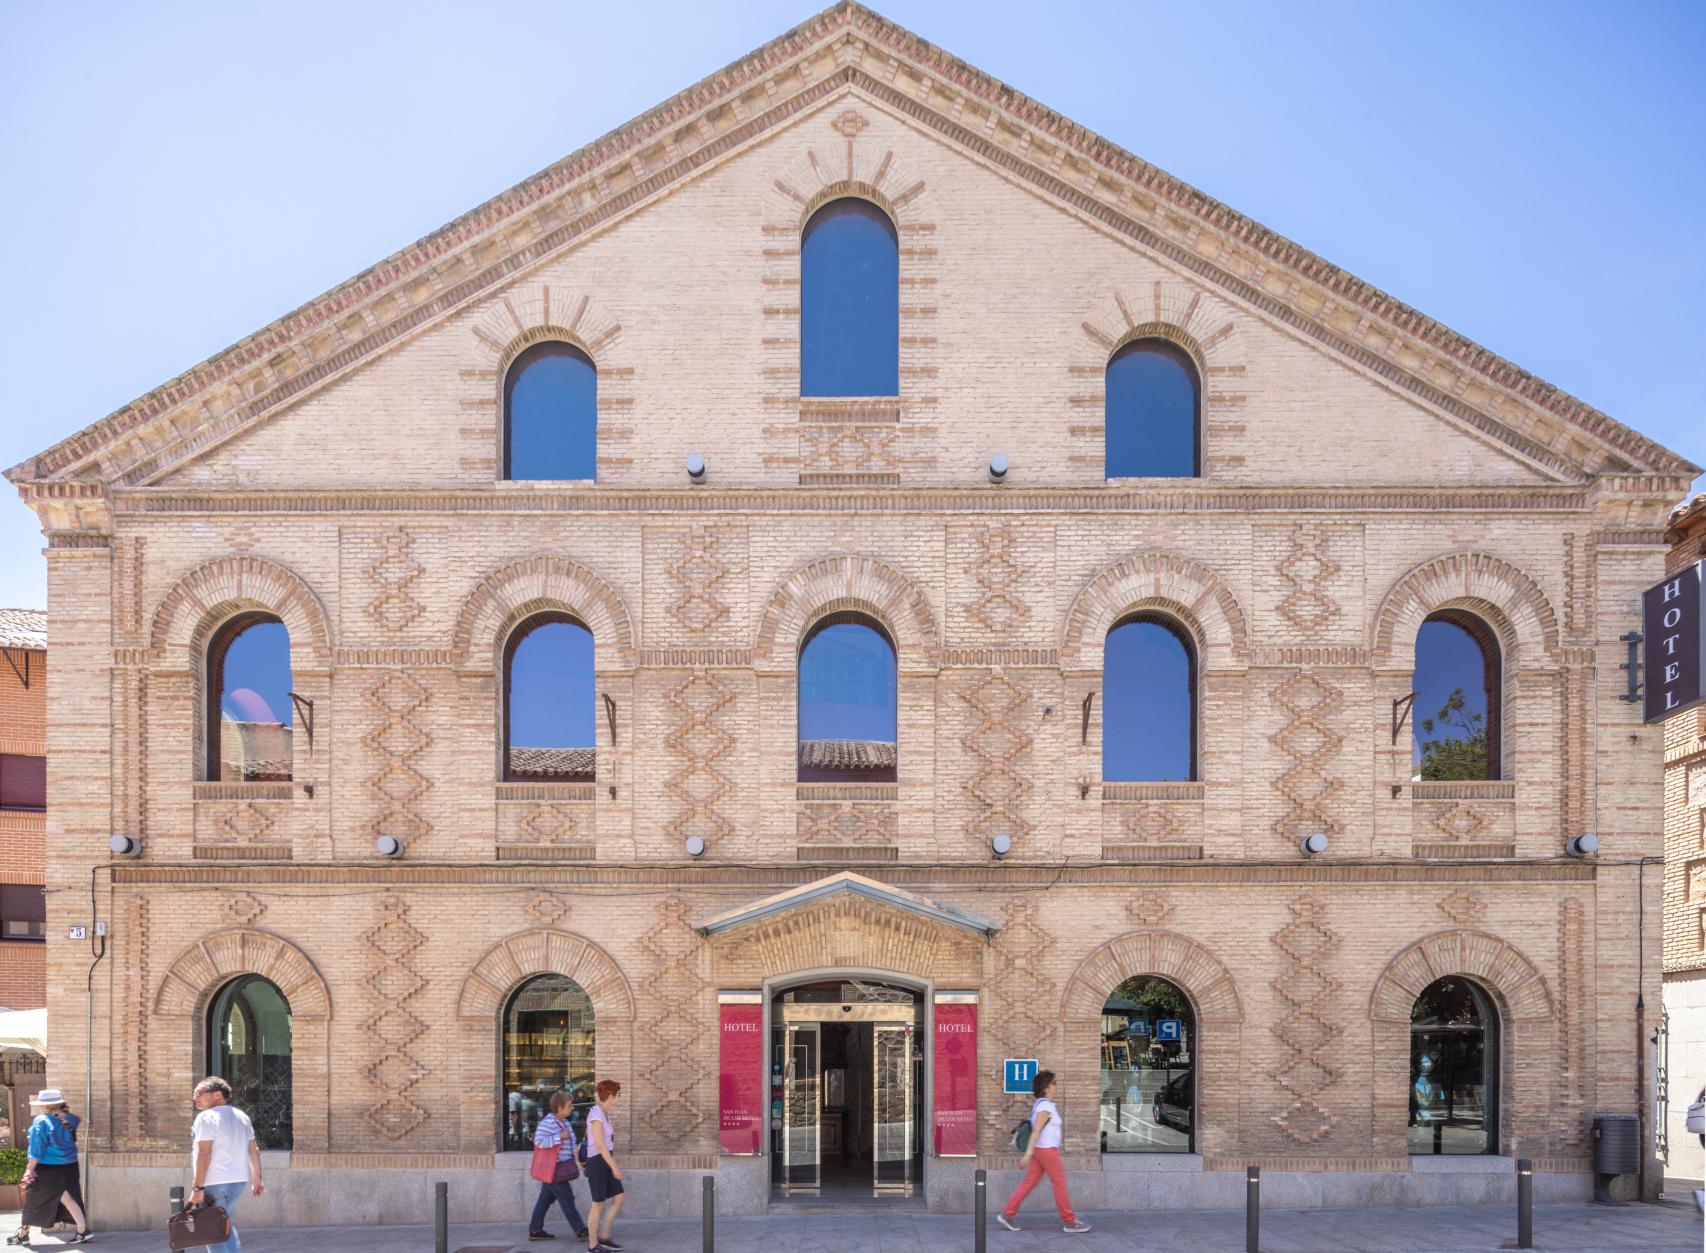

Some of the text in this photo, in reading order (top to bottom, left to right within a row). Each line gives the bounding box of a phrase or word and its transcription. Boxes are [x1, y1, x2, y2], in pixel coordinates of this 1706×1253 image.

[1663, 578, 1681, 711] HOTEL
[724, 1023, 759, 1032] HOTEL
[938, 1023, 974, 1033] HOTEL
[1014, 1063, 1028, 1081] H
